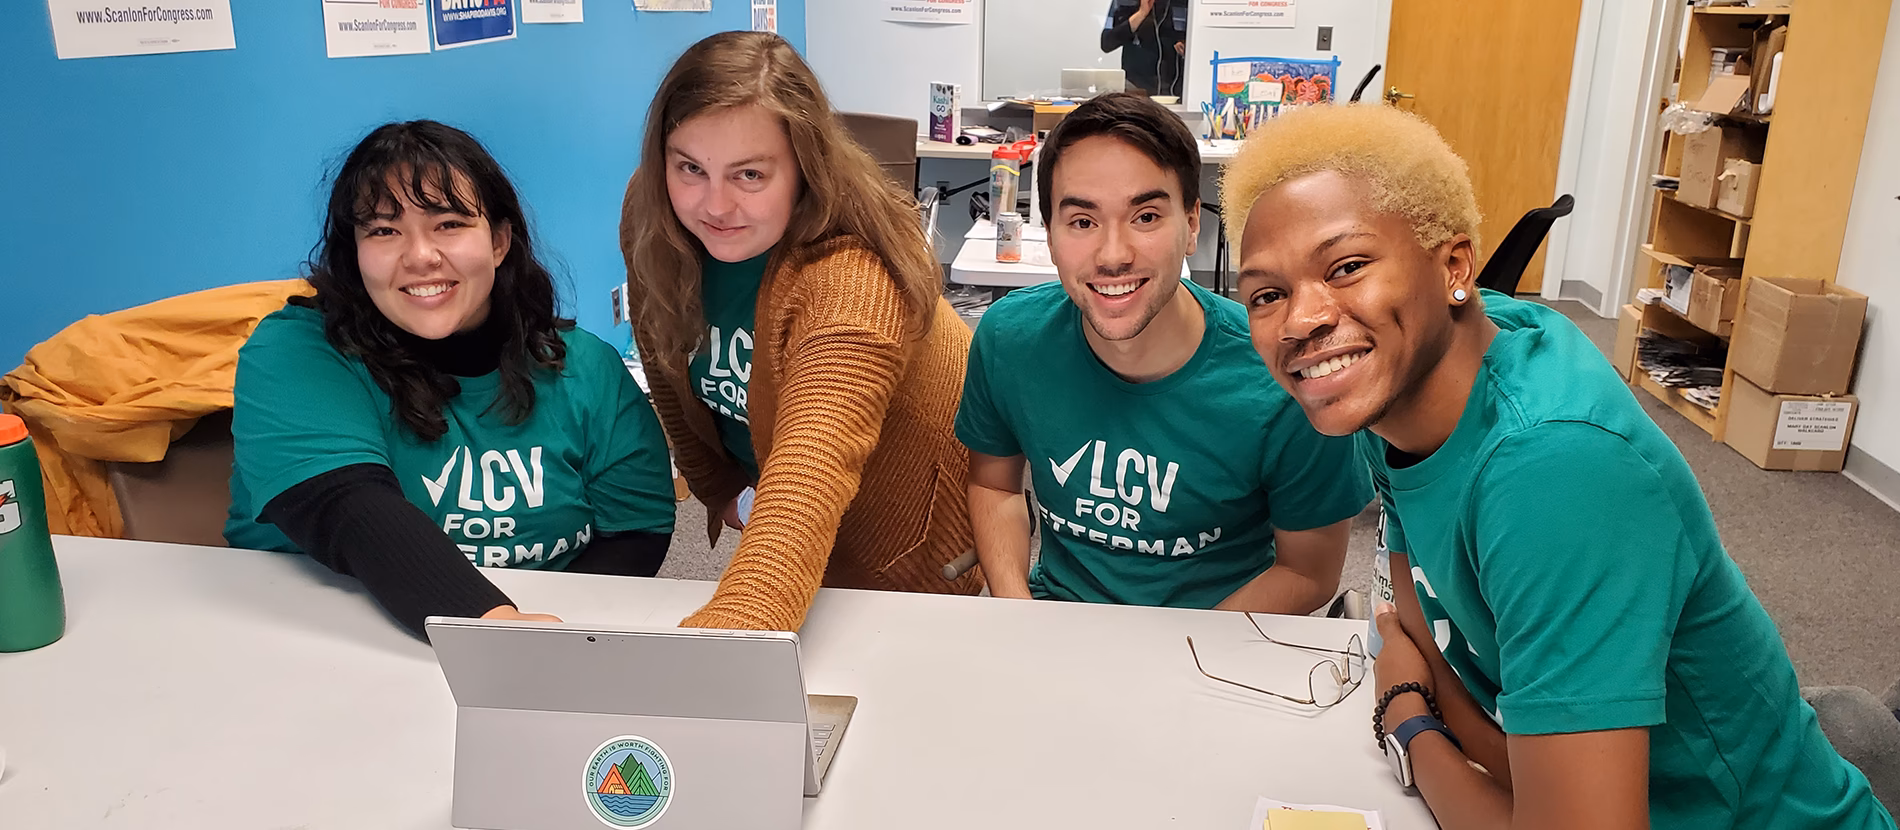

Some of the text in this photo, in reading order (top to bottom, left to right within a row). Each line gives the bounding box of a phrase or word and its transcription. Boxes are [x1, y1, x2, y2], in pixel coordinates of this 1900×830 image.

[76, 7, 213, 24] www.ScanlonForCongress.com
[338, 19, 416, 33] www.ScanlonForCongress.com
[709, 325, 755, 383] LC
[701, 377, 748, 412] FOR
[458, 445, 544, 511] LCV
[1089, 440, 1179, 512] LCV
[443, 513, 516, 538] FOR
[1038, 502, 1222, 556] ETTERMAN
[1075, 498, 1141, 532] FOR
[456, 523, 592, 567] ERMAN
[592, 750, 609, 770] EARTH
[645, 746, 667, 775] FIGHTING
